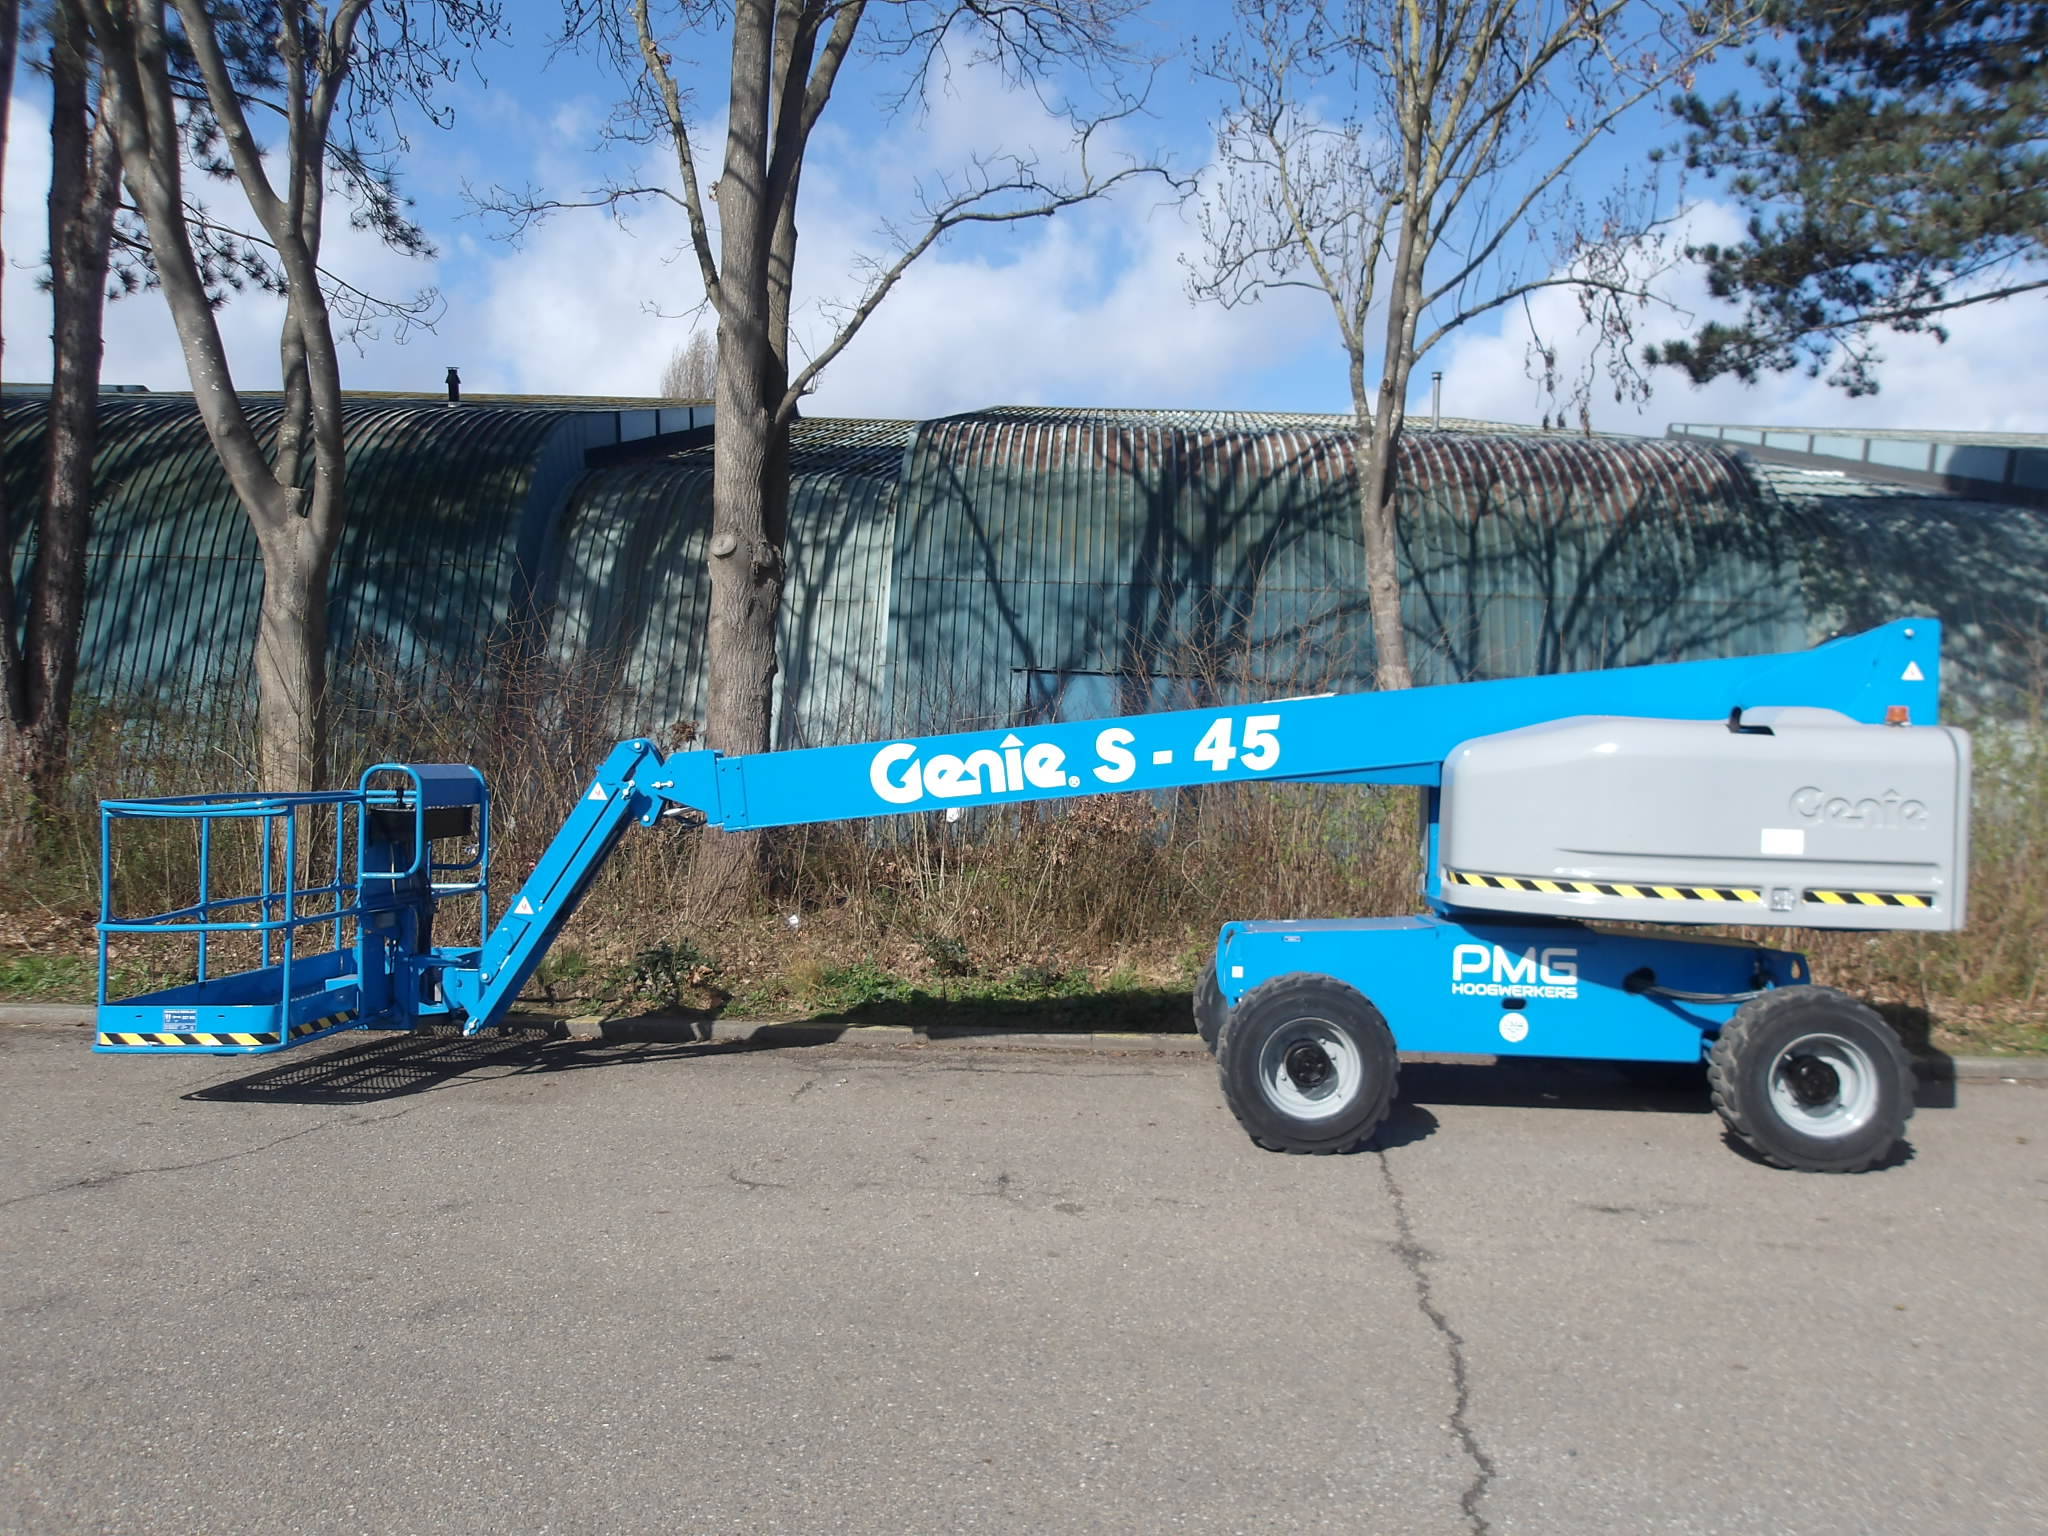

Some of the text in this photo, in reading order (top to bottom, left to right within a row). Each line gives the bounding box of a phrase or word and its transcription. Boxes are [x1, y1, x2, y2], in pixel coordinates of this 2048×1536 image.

[1093, 728, 1136, 783] S
[1194, 714, 1281, 772] 45
[1789, 786, 1928, 829] Genie
[1453, 944, 1578, 985] PMG
[1452, 983, 1578, 999] HOOGWERKERS
